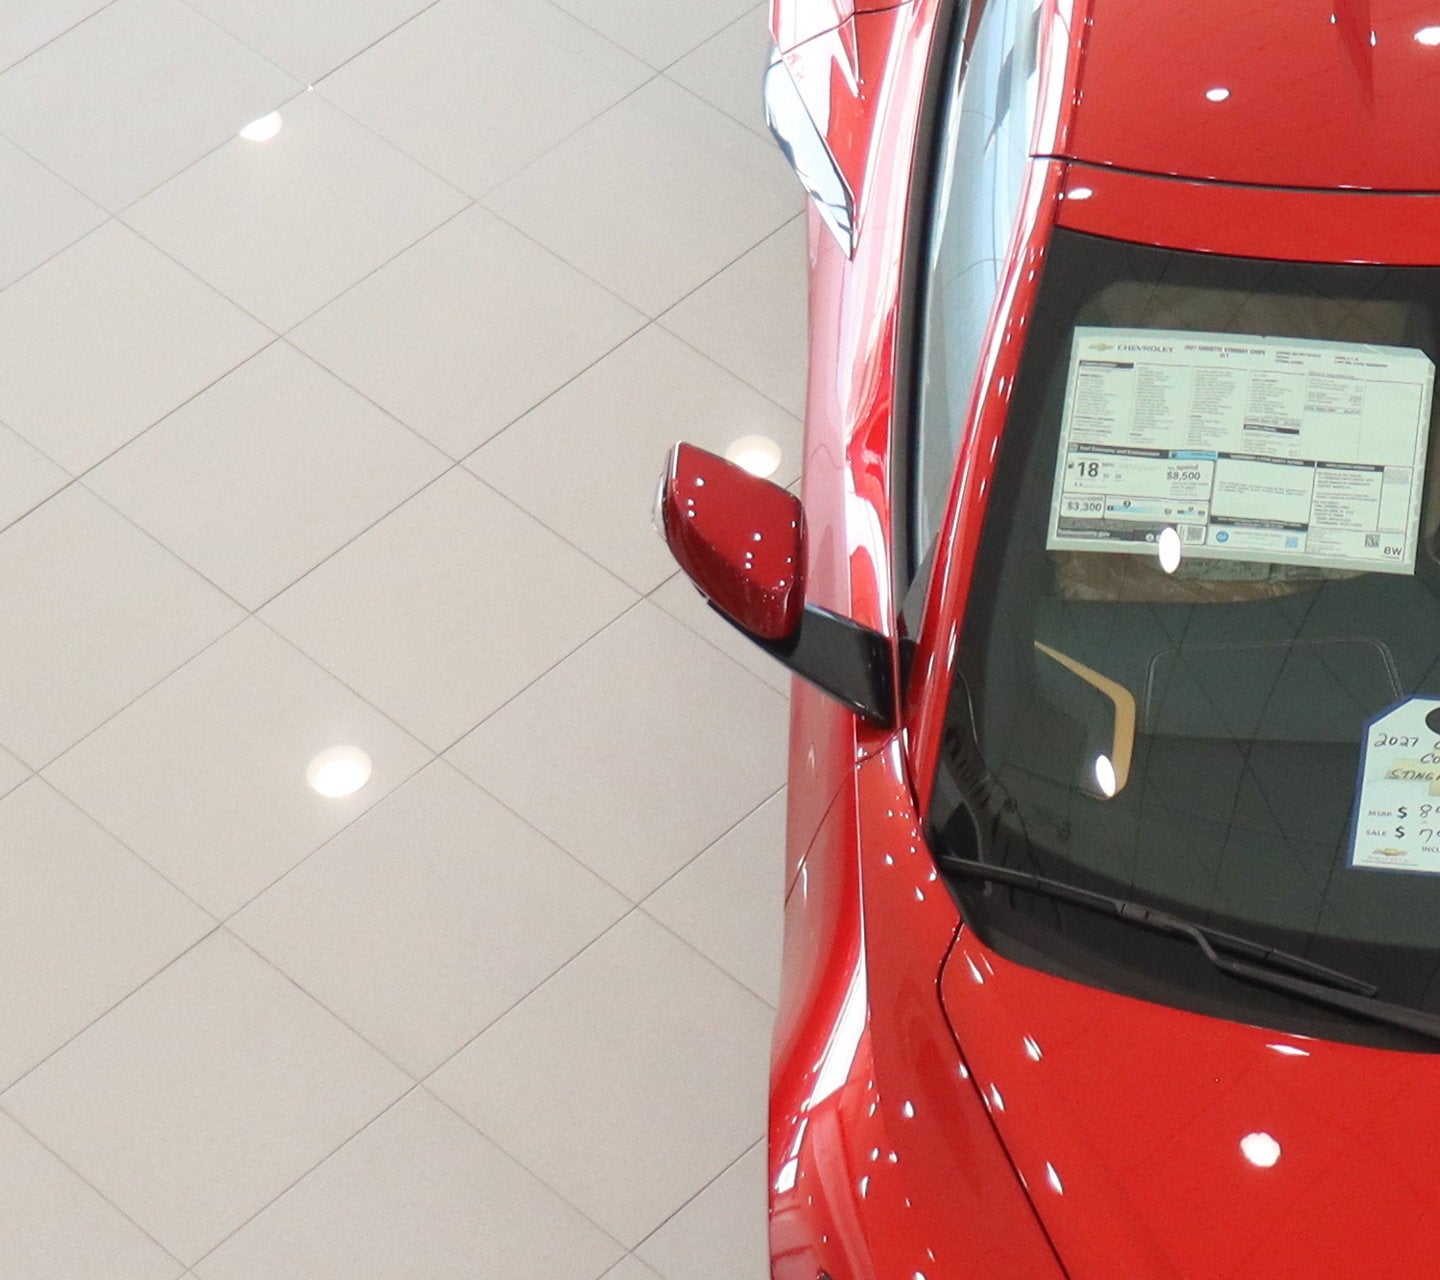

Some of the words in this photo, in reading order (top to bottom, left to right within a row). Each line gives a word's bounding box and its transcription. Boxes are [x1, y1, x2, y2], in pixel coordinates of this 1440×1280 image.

[1116, 343, 1175, 355] CHEVROLET
[1076, 460, 1100, 478] 18
[1166, 471, 1201, 482] $8,500
[1067, 500, 1103, 513] $3,300
[1373, 732, 1419, 748] 2027
[1396, 806, 1408, 820] $
[1366, 829, 1388, 837] SALE
[1394, 825, 1406, 839] $
